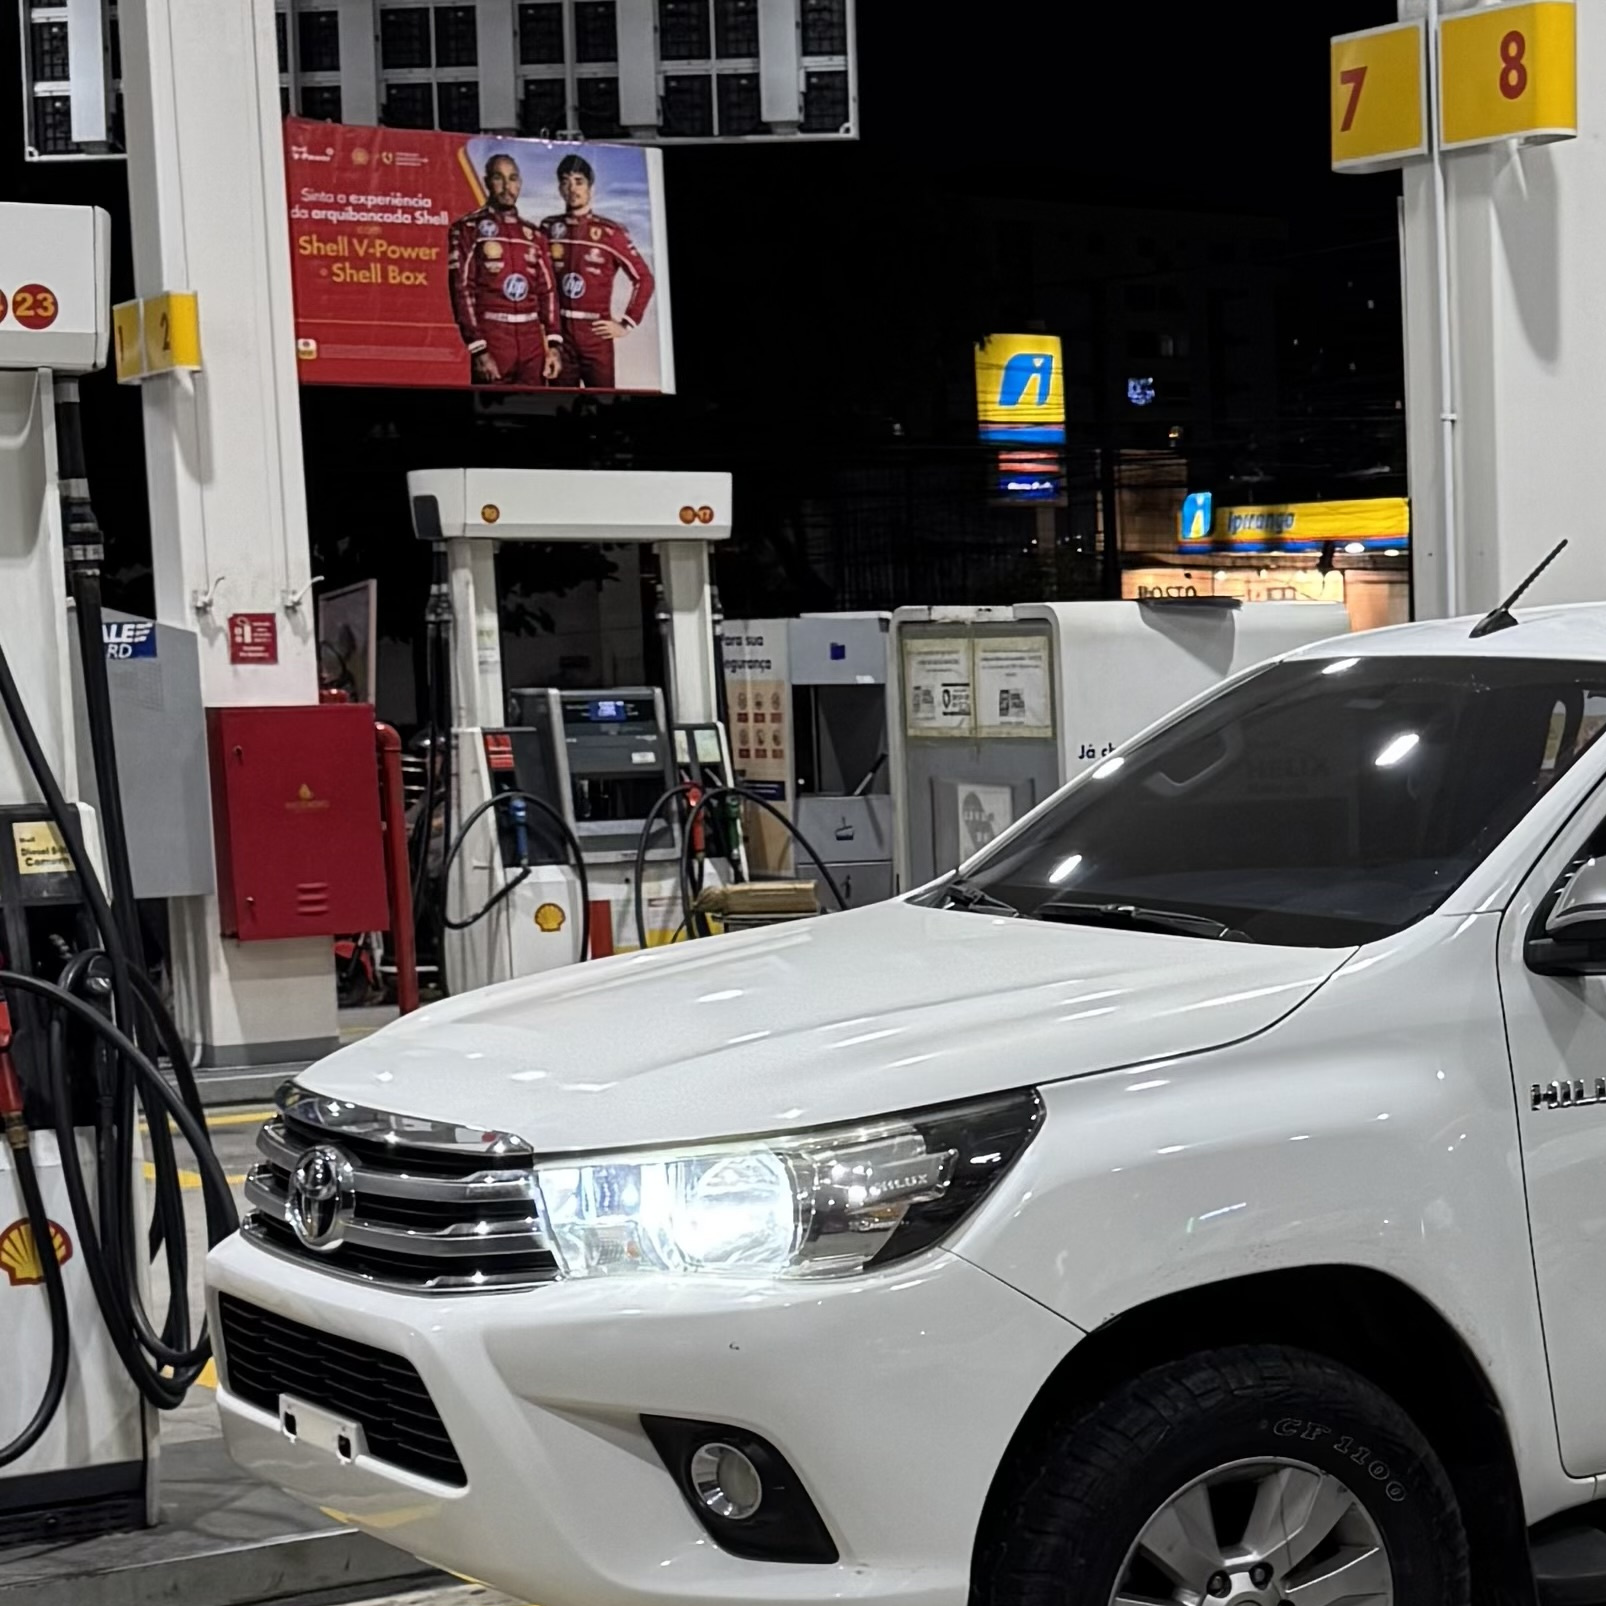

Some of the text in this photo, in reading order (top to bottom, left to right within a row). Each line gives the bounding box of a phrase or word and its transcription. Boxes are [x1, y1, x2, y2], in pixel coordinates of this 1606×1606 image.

[1500, 30, 1527, 99] 8
[1340, 66, 1368, 132] 7
[301, 187, 432, 208] Sinta a experiência
[311, 206, 411, 224] arquibancada
[414, 211, 449, 225] Shell
[299, 234, 440, 260] Shell V-Power
[332, 262, 428, 285] Shell Box
[15, 292, 55, 317] 23
[160, 312, 170, 351] 2
[1078, 744, 1096, 759] Já
[1273, 1418, 1406, 1502] CF 1100
